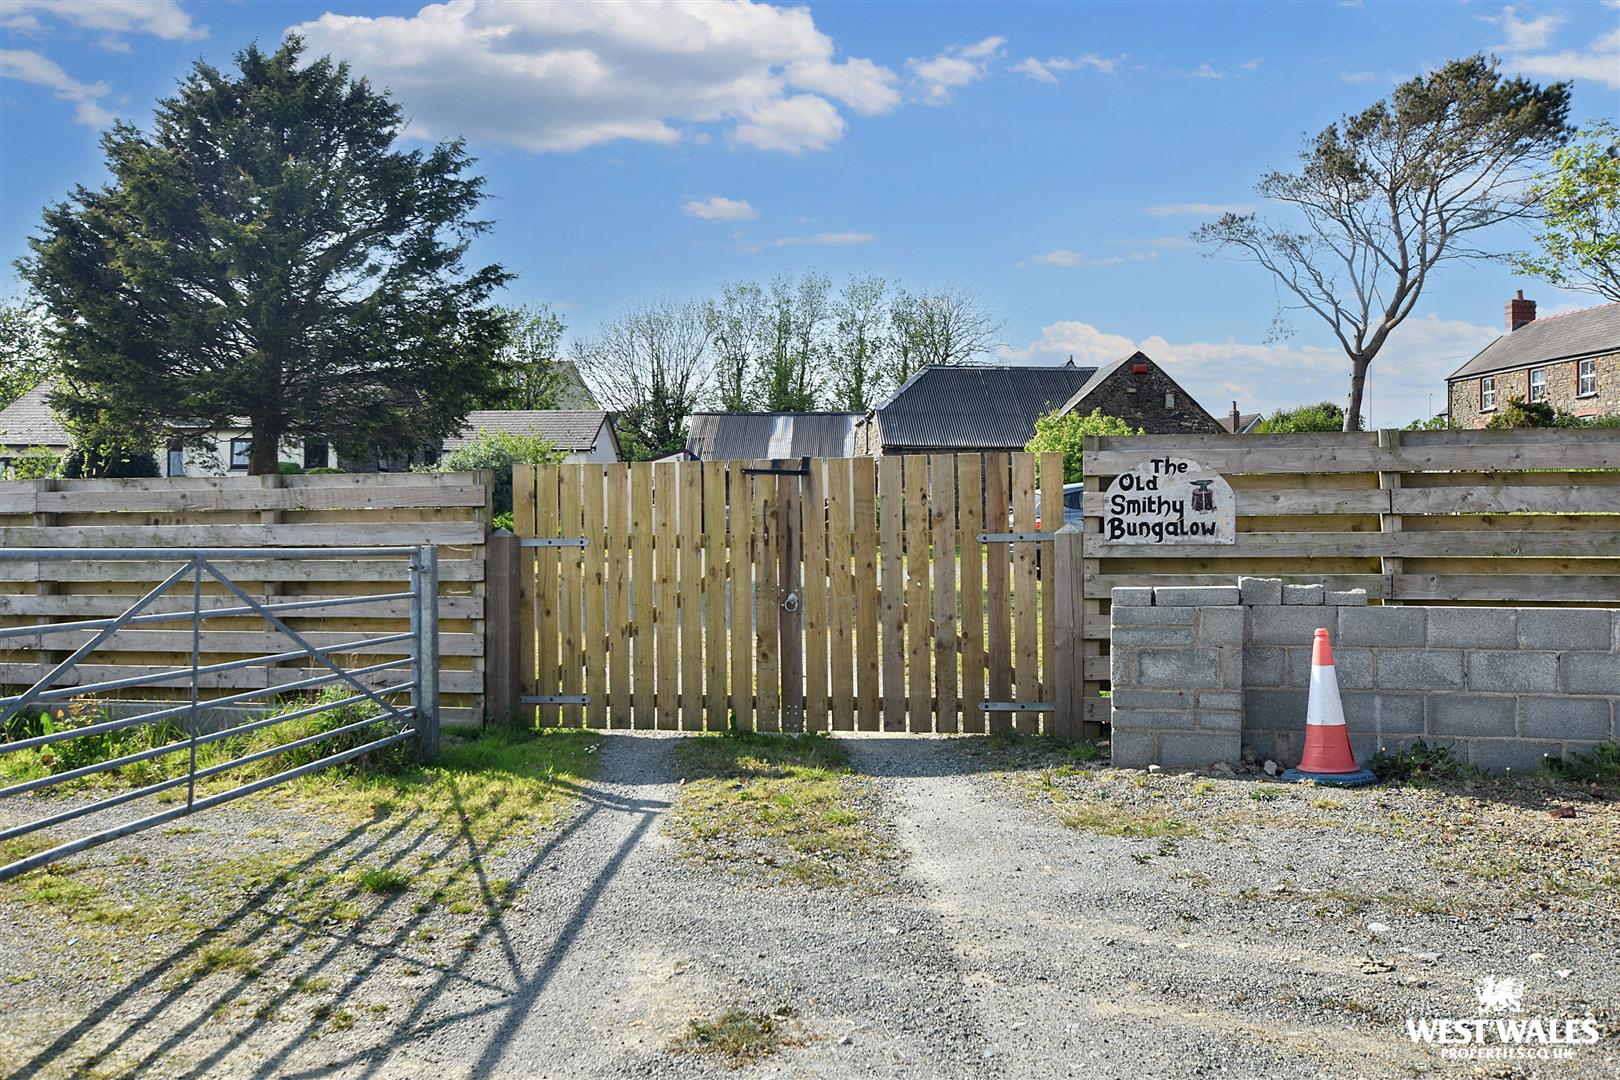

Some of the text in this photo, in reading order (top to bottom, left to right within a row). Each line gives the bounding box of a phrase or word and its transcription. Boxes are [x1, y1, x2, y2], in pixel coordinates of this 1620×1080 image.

[1150, 458, 1188, 475] The
[1119, 473, 1159, 491] Old
[1110, 494, 1185, 522] Smithy
[1107, 517, 1216, 543] Bungalow
